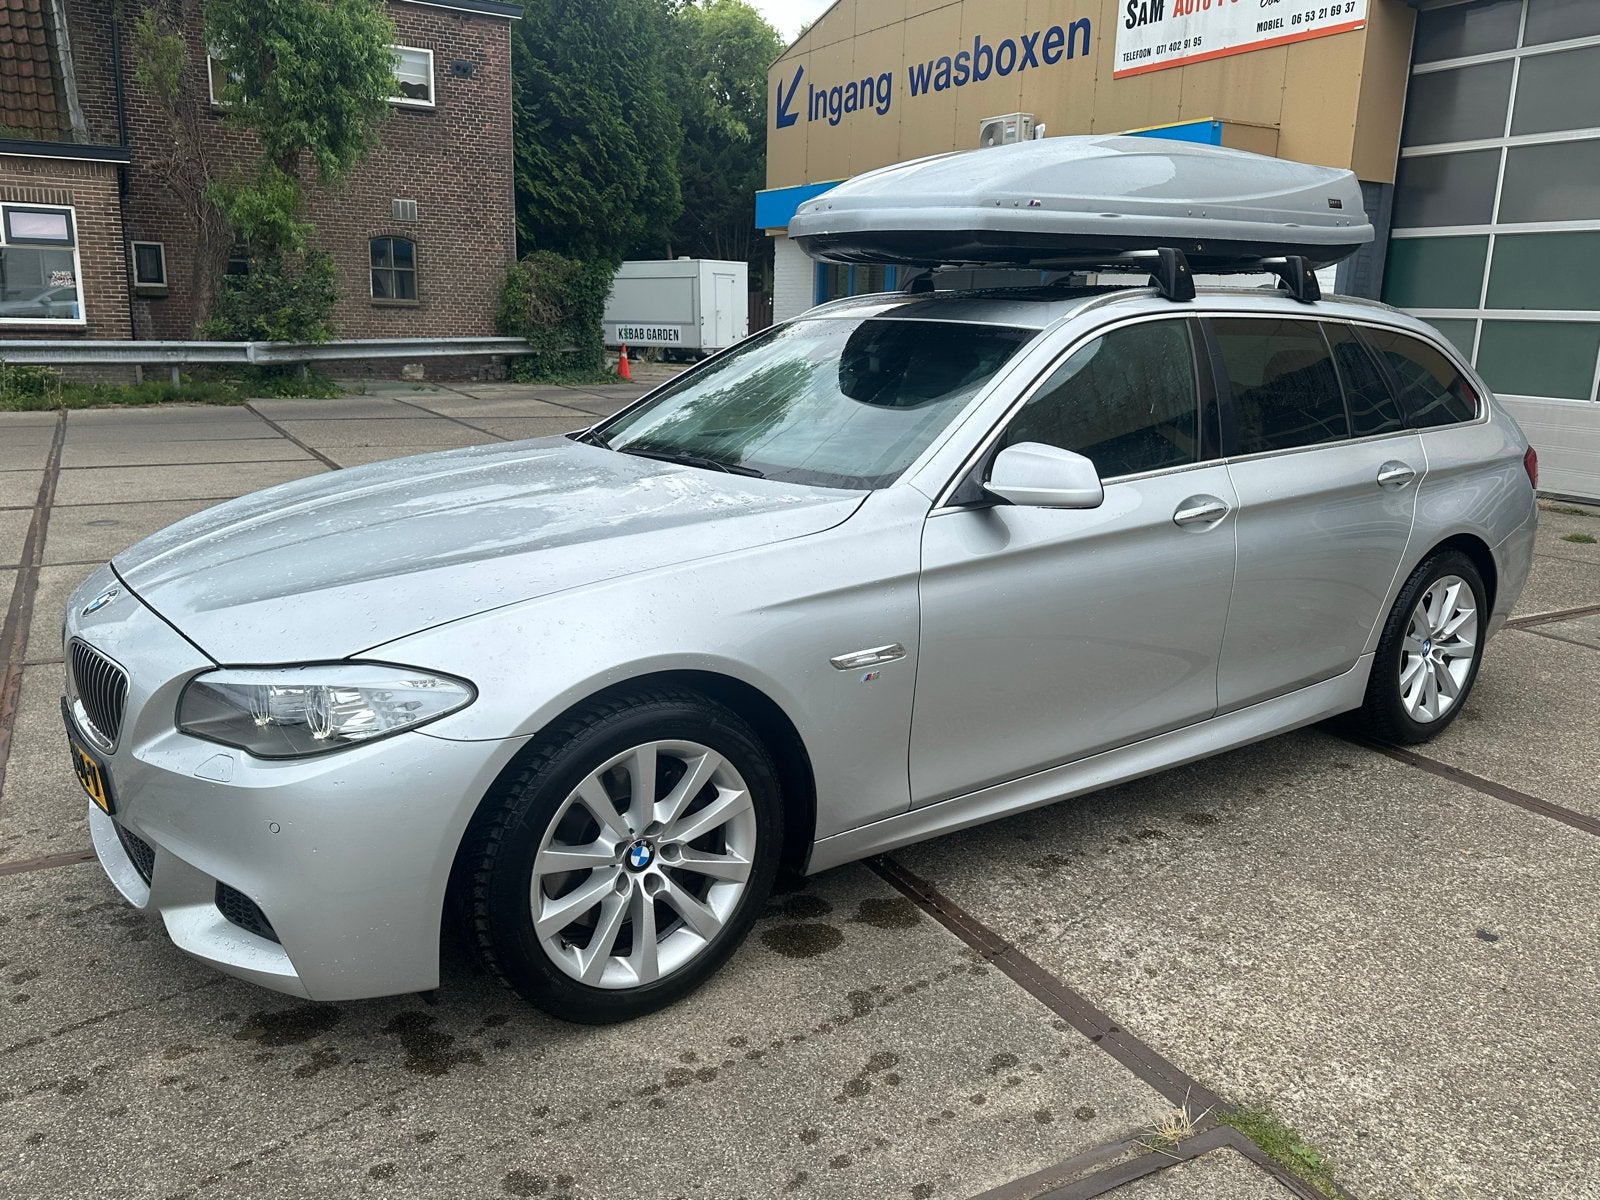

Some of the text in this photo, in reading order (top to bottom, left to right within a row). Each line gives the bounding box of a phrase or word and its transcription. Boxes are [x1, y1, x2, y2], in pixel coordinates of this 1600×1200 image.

[1125, 0, 1164, 29] SAM
[1256, 1, 1355, 32] MOBIEL 06 53 21 69 37
[1123, 36, 1202, 62] TELEFOON 071 402 91 95
[808, 17, 1091, 126] Ingang wasboxen
[646, 328, 679, 341] GARDEN
